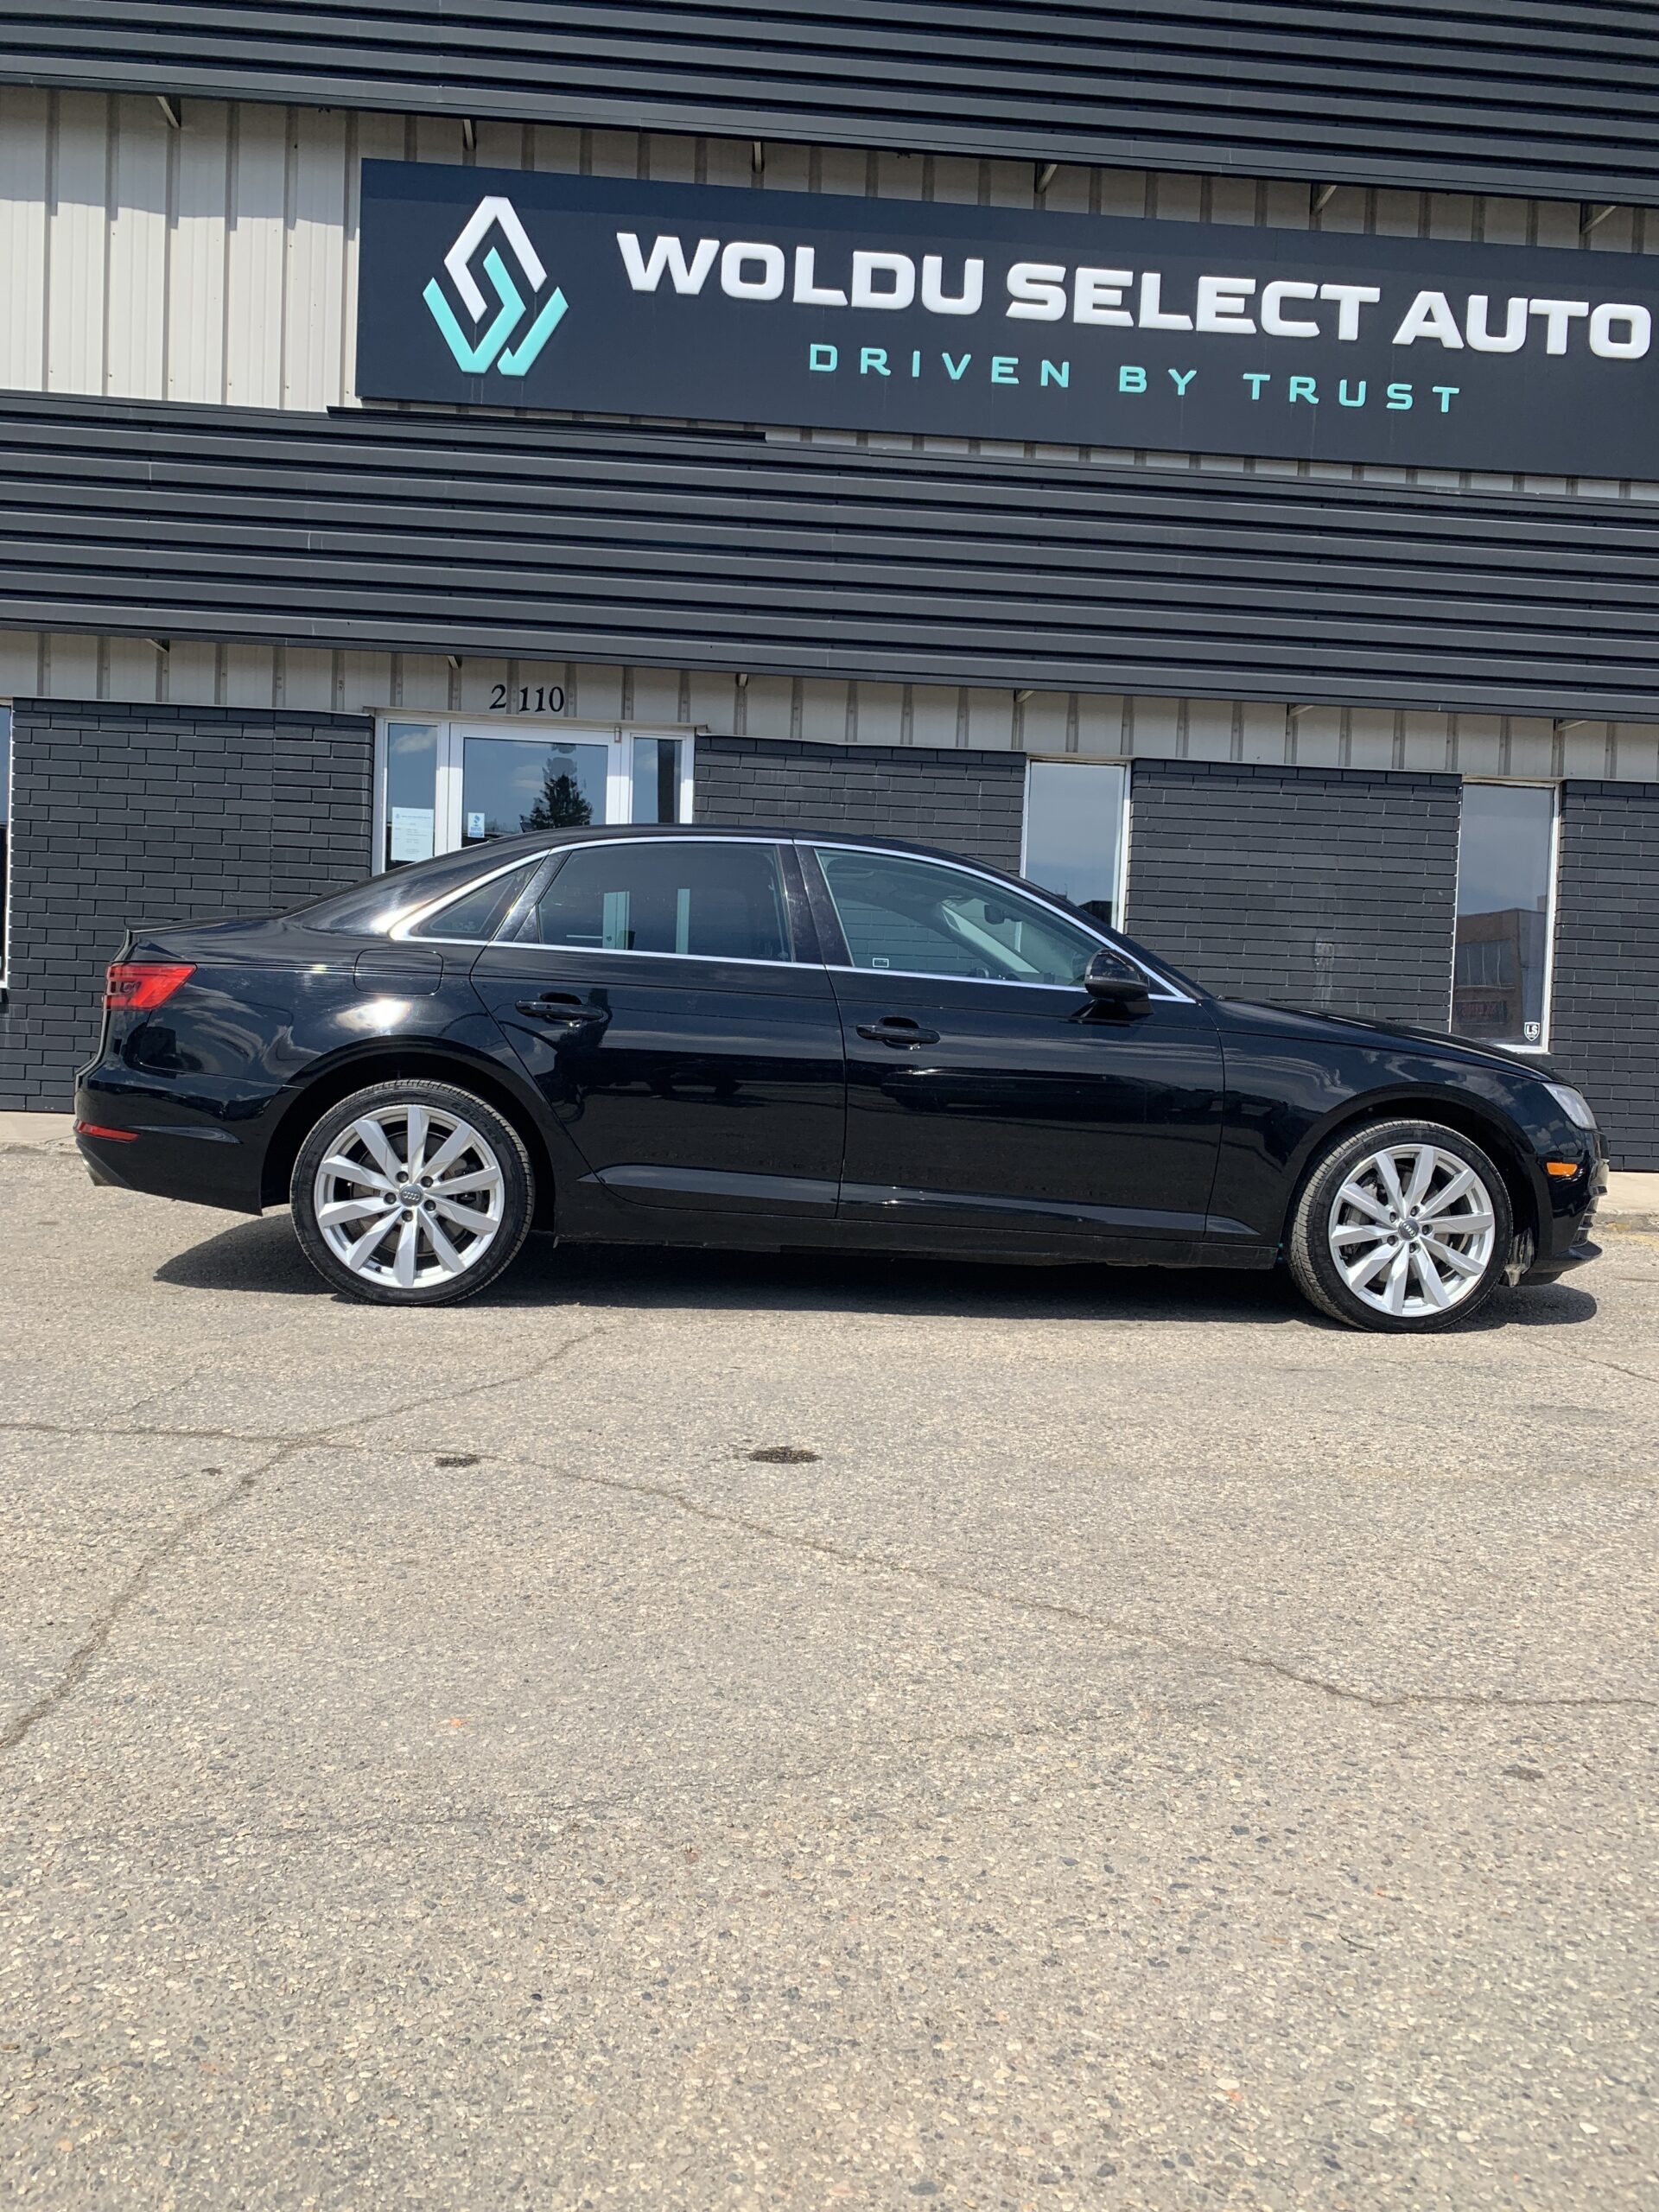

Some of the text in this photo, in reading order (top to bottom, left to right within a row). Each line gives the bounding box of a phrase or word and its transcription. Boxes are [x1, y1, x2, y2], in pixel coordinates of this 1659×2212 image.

[616, 231, 1652, 359] WOLDU SELECT AUTO
[809, 343, 1460, 413] DRIVEN BY TRUST
[1526, 1025, 1538, 1035] LS
